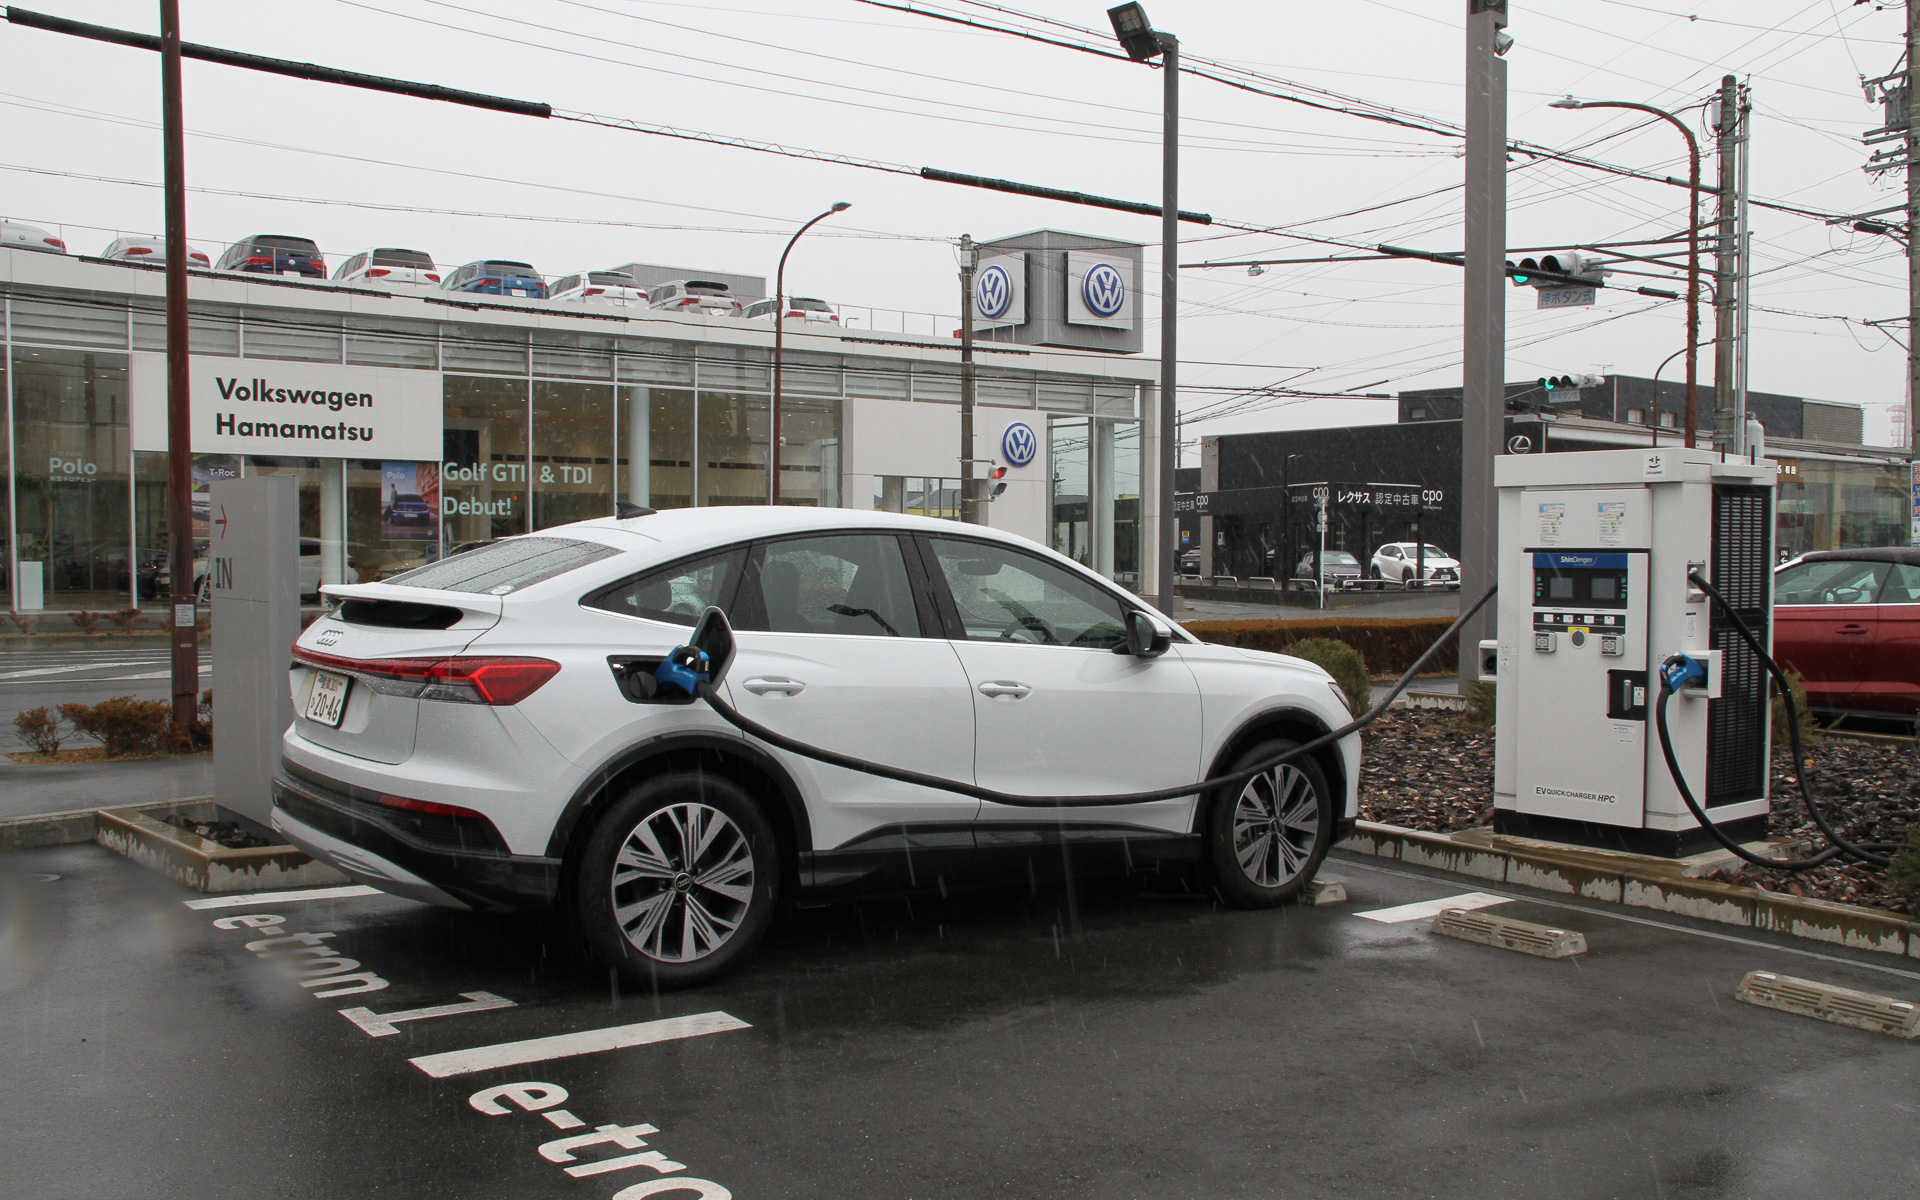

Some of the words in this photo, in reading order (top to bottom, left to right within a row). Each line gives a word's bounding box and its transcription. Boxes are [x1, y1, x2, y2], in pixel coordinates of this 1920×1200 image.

[215, 377, 373, 412] Volkswagen
[215, 412, 374, 442] Hamamatsu
[49, 457, 98, 475] Polo
[208, 468, 236, 477] T-Roc
[386, 471, 405, 480] Polo
[443, 462, 488, 482] Golf
[492, 464, 526, 482] GTI
[539, 465, 555, 484] &
[560, 466, 593, 485] TDI
[443, 496, 512, 516] Debut!
[1337, 491, 1371, 504] レクサス
[1375, 492, 1419, 506] 認定中古車
[1422, 489, 1443, 505] cpo
[1560, 556, 1593, 564] ShinDengen
[215, 557, 232, 590] IN
[313, 692, 341, 722] 20-46
[1536, 786, 1547, 795] EV
[1546, 788, 1566, 797] QUICK
[1566, 791, 1597, 801] CHARGER
[1597, 794, 1616, 804] HPC
[212, 914, 390, 999] e-tron
[338, 990, 518, 1038] 1
